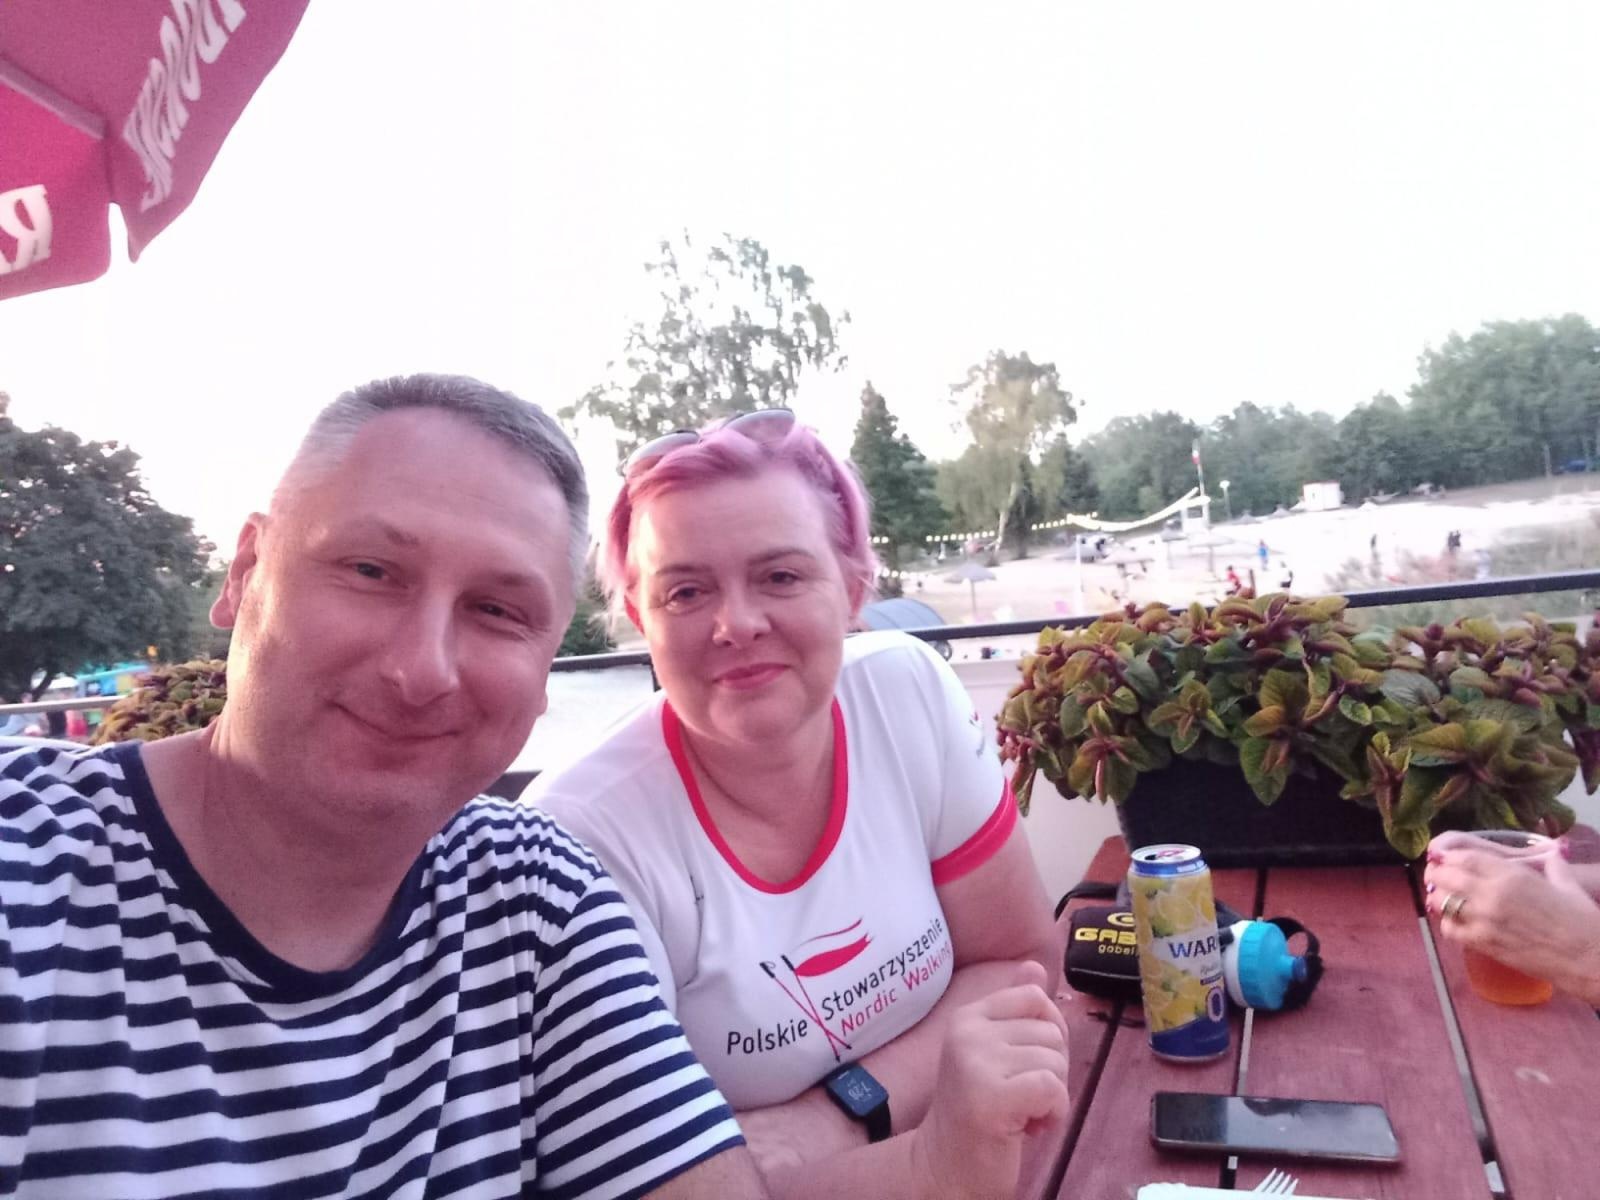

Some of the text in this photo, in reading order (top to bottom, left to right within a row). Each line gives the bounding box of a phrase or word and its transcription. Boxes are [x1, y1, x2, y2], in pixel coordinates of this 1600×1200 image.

[1075, 927, 1137, 945] GAB
[1168, 935, 1217, 958] WAR
[727, 918, 942, 1055] Polskie Stowarzyszenie
[841, 988, 897, 1036] Nordic
